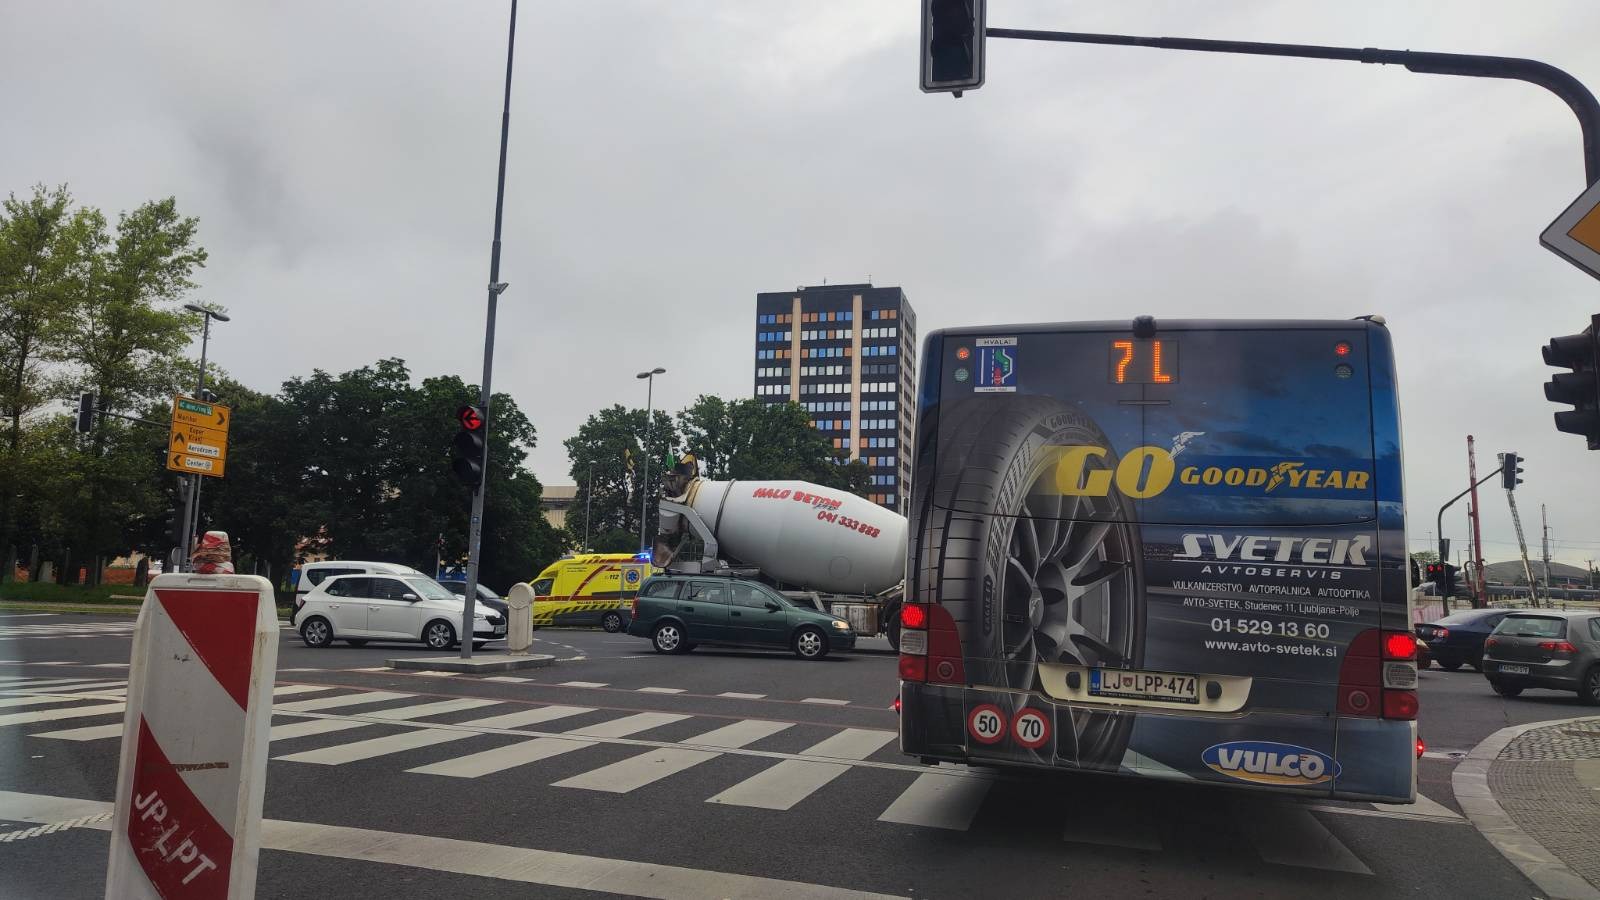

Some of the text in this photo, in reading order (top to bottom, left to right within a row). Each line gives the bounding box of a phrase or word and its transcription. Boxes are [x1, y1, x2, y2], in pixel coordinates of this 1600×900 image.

[1114, 341, 1170, 384] 7 L
[1053, 444, 1176, 499] GO
[753, 488, 792, 499] HALO
[792, 490, 842, 508] BETON
[817, 510, 880, 538] 041 333 888
[1173, 533, 1371, 565] SVETEK
[1201, 565, 1342, 580] AVTOSERVIS
[1173, 580, 1371, 600] VULKANIZERSTVO AVTOPRALNICA AVTOOPTIKA
[1183, 597, 1242, 609] AVTO-SVETEK,
[1244, 601, 1282, 611] Studenec
[1299, 604, 1360, 616] Ljubljana-Polje
[1211, 617, 1330, 639] 01 529 13 60
[1205, 639, 1337, 658] www.avto-svetek.si
[1103, 672, 1121, 690] LJ
[978, 715, 998, 734] 50
[1022, 718, 1041, 738] 70
[1218, 748, 1325, 779] VULCO
[134, 790, 217, 885] JP LPT
